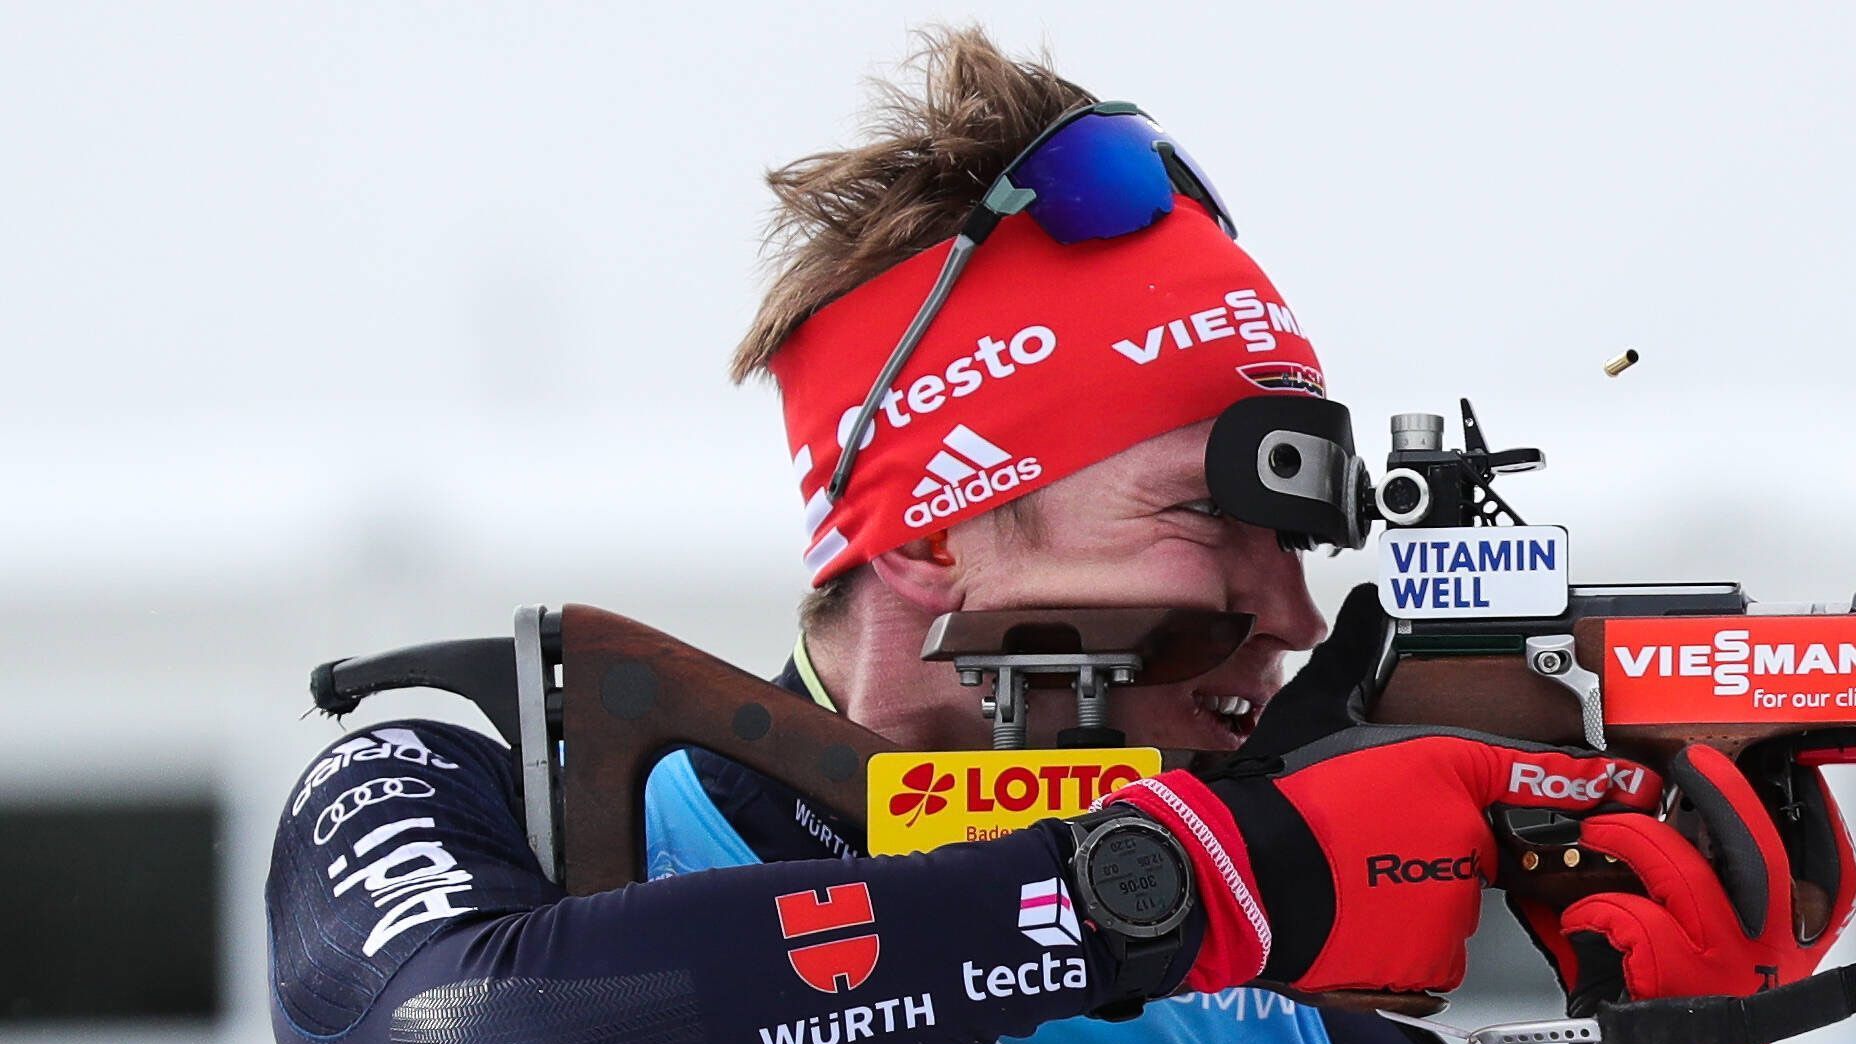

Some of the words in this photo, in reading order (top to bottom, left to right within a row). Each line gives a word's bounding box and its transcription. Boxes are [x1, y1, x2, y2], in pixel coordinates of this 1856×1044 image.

[1112, 289, 1307, 365] VIESSM
[879, 325, 1057, 428] testo
[903, 457, 1043, 528] adidas
[1390, 539, 1556, 573] VITAMIN
[1390, 576, 1490, 609] WELL
[1753, 688, 1784, 708] for
[1792, 690, 1830, 708] our
[963, 951, 1087, 1002] tecta
